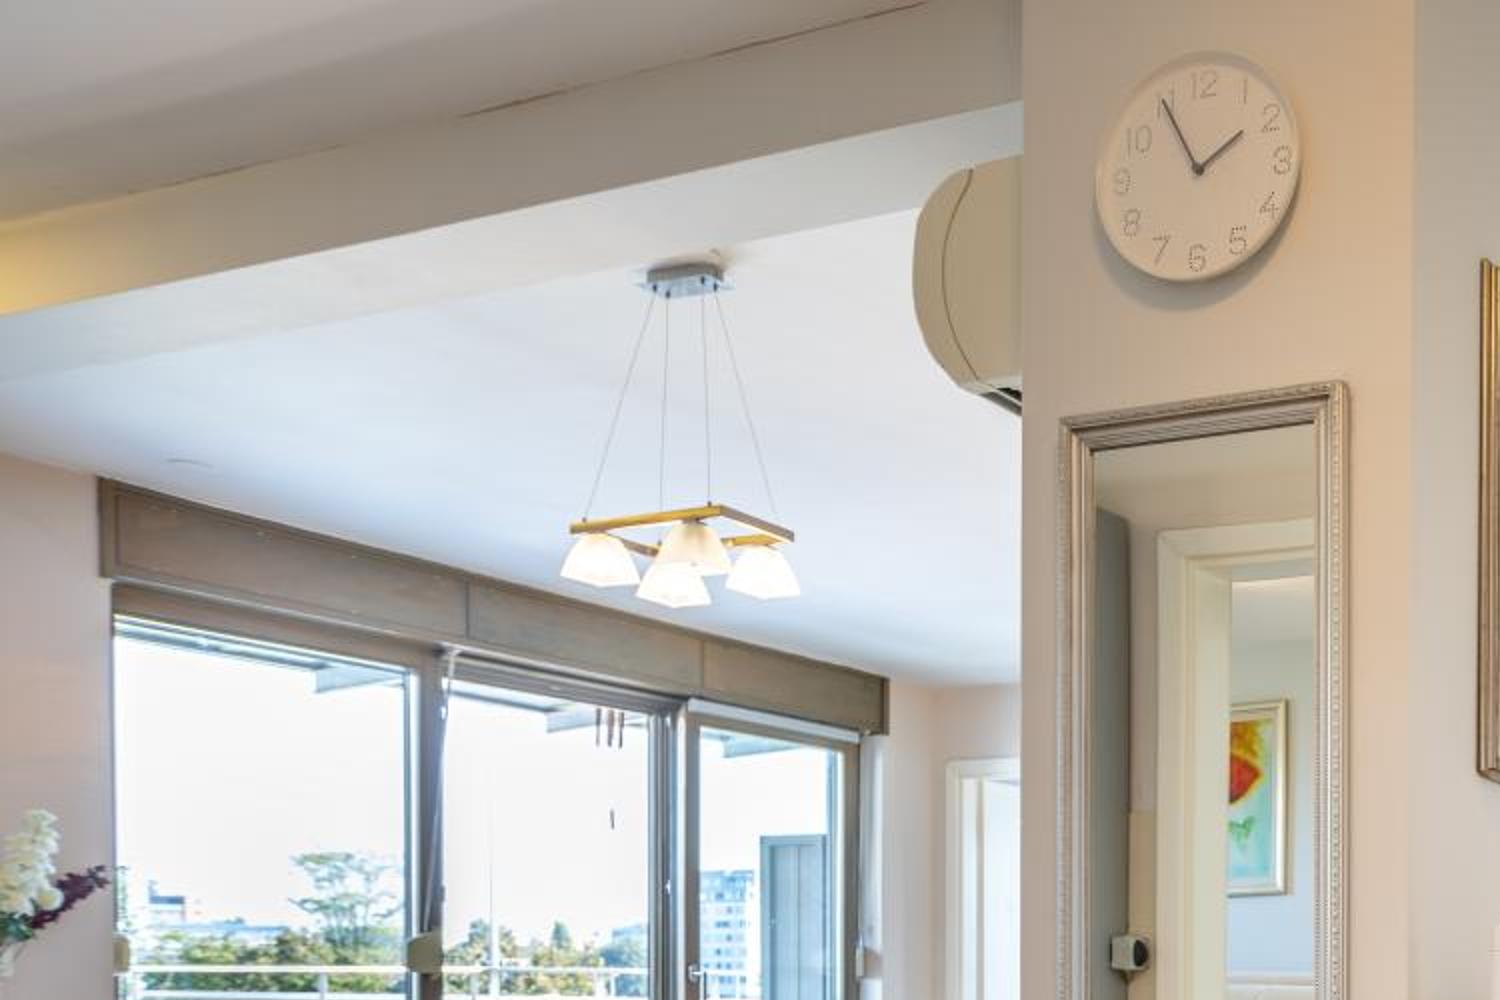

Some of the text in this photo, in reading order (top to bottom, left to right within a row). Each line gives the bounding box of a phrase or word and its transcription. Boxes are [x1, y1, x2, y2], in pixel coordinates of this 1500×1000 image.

[1191, 70, 1217, 100] 12
[1261, 103, 1280, 133] 2
[1126, 125, 1152, 159] 10
[1273, 145, 1291, 175] 3
[1114, 168, 1131, 196] 9
[1259, 190, 1279, 220] 4
[1123, 208, 1141, 238] 8
[1152, 234, 1170, 266] 7
[1229, 225, 1247, 256] 5
[1188, 243, 1207, 272] 6
